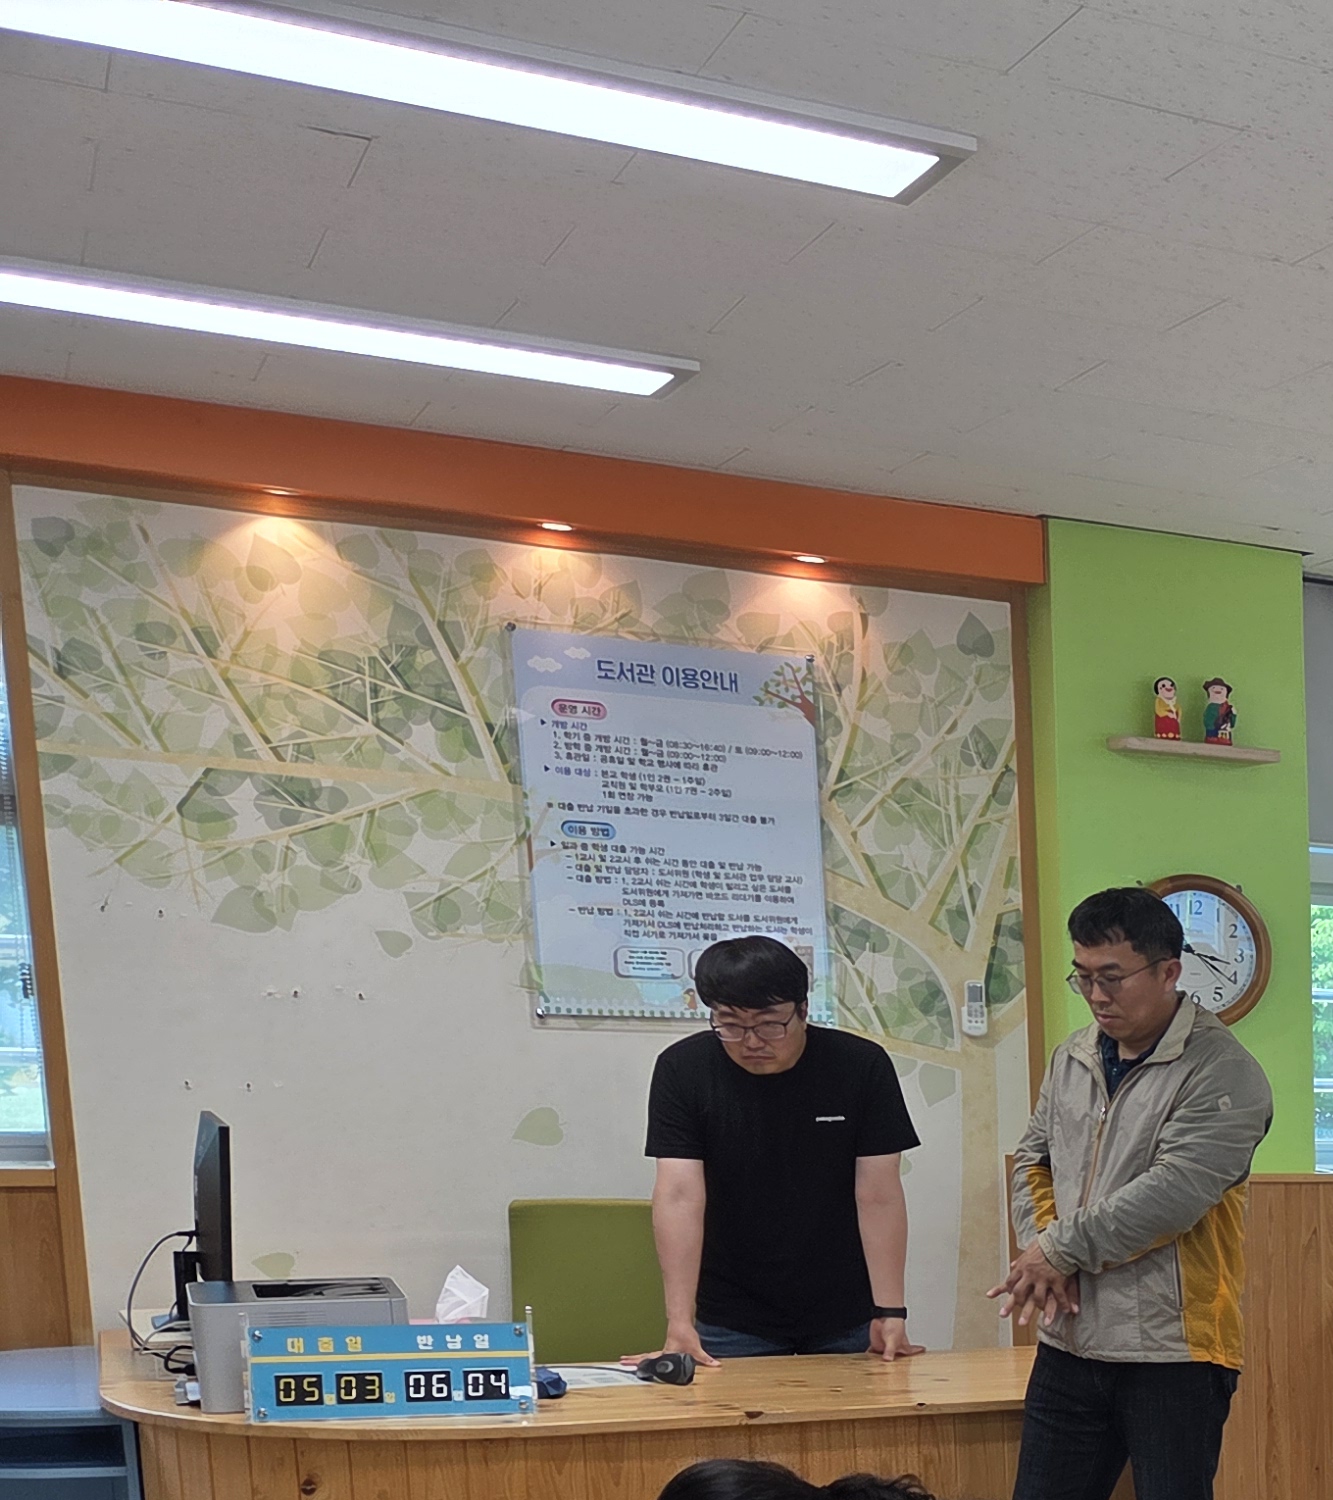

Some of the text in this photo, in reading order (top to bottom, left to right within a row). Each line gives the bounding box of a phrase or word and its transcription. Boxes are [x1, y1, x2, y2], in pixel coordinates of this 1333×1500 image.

[597, 659, 739, 693] 도서관 이용안내
[558, 703, 601, 716] 운영 시간
[571, 722, 588, 731] 시간
[614, 736, 630, 745] 시간
[614, 746, 631, 755] 시간
[567, 825, 610, 837] 이용 방법
[648, 847, 665, 856] 시간
[663, 858, 679, 868] 시간
[1189, 899, 1203, 915] 12
[1228, 923, 1238, 938] 2
[1234, 948, 1245, 963] 3
[1228, 970, 1238, 985] 4
[1190, 990, 1201, 1005] 6
[1212, 986, 1223, 1002] 5
[279, 1377, 319, 1402] 05
[340, 1375, 380, 1400] 03
[409, 1373, 448, 1399] 06
[467, 1372, 506, 1397] 04
